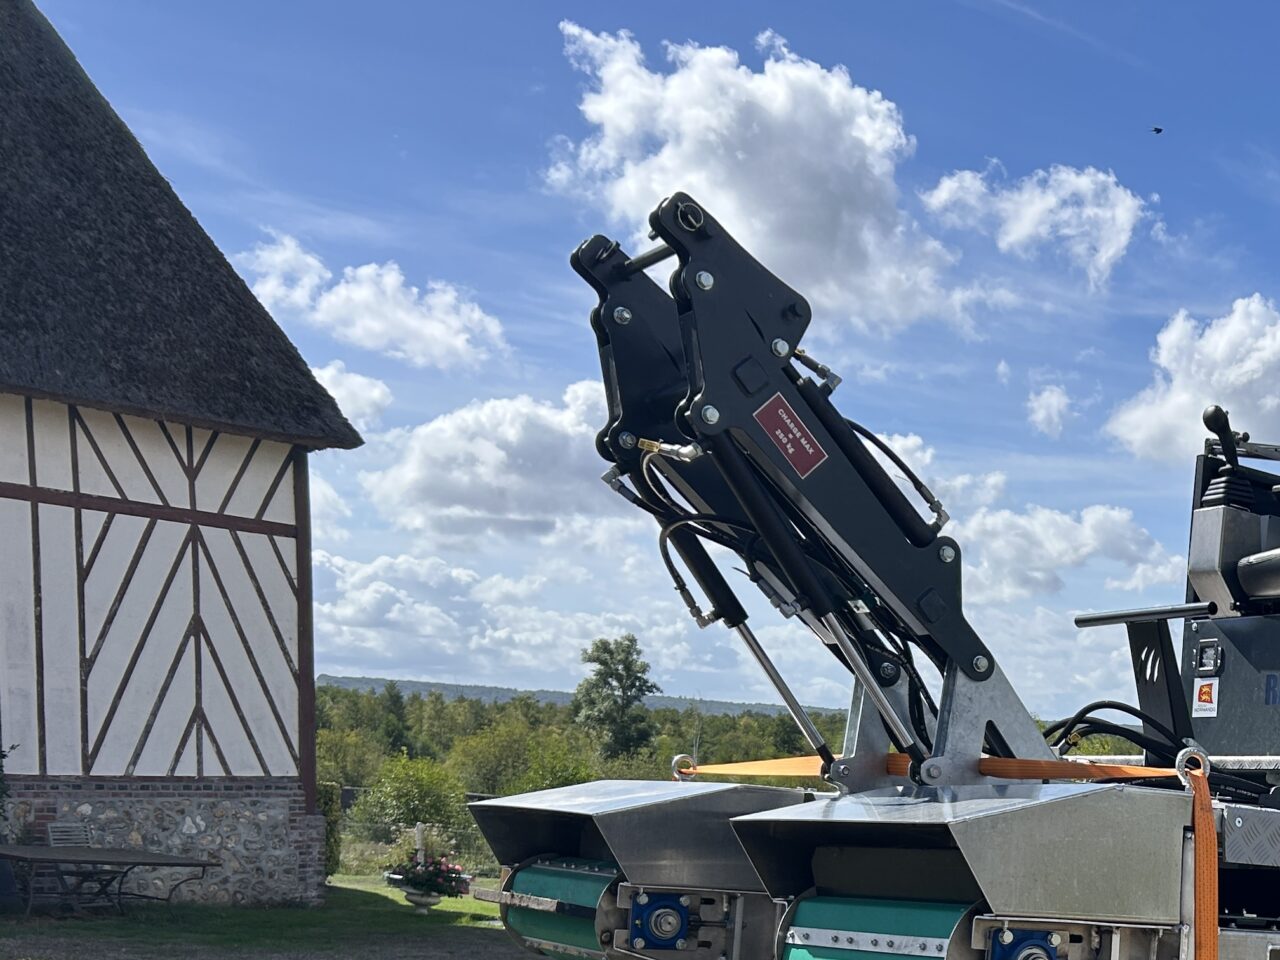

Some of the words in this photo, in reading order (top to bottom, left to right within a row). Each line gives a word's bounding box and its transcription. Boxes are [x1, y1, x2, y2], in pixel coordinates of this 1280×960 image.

[775, 429, 788, 443] 250
[778, 409, 801, 438] CHARGE
[800, 437, 814, 455] MAX
